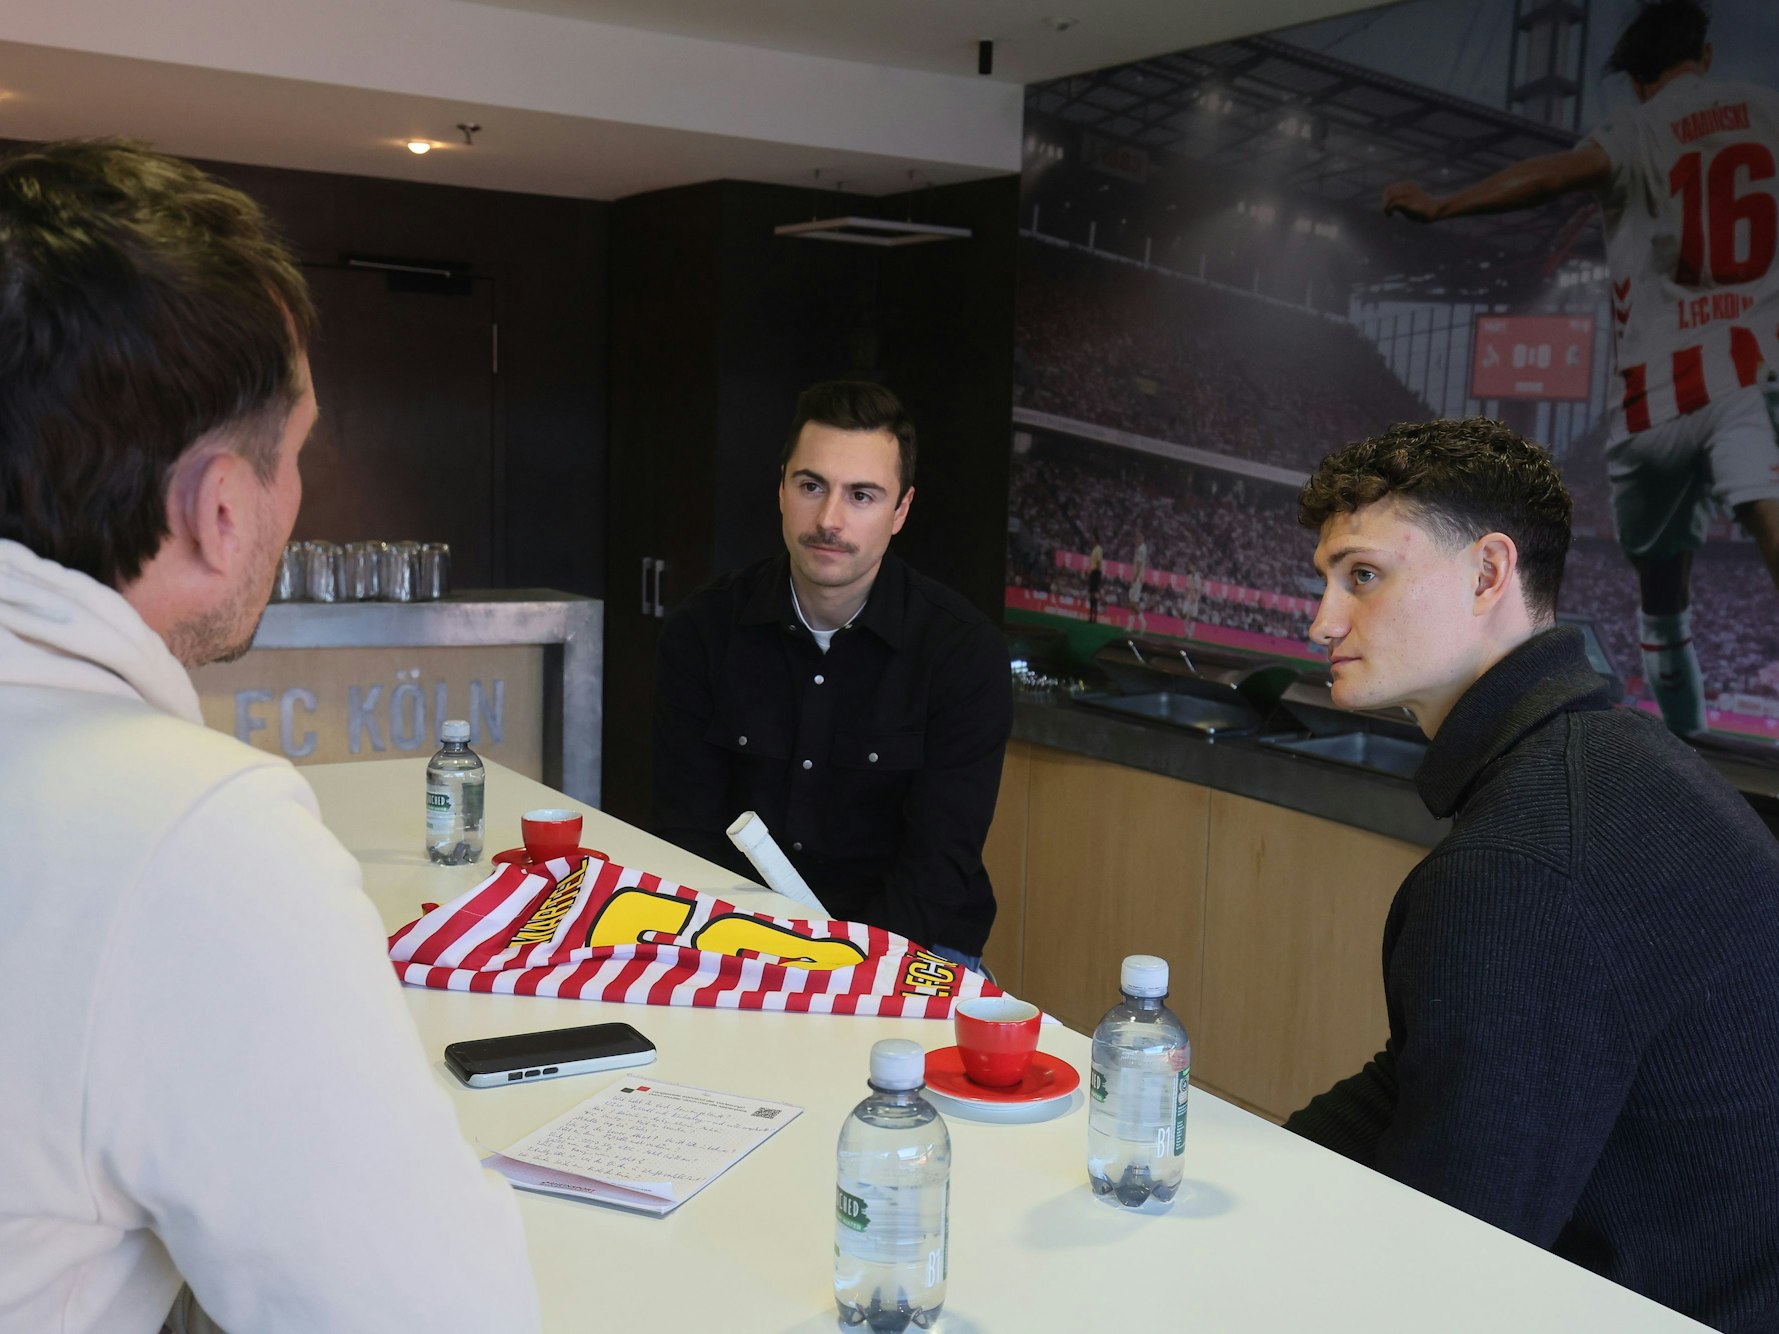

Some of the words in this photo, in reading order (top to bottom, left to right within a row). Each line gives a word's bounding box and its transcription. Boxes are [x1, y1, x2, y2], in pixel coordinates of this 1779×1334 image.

[1669, 142, 1779, 286] 16
[235, 687, 318, 757] FC
[1156, 1126, 1171, 1159] B1
[927, 1247, 941, 1288] B1
